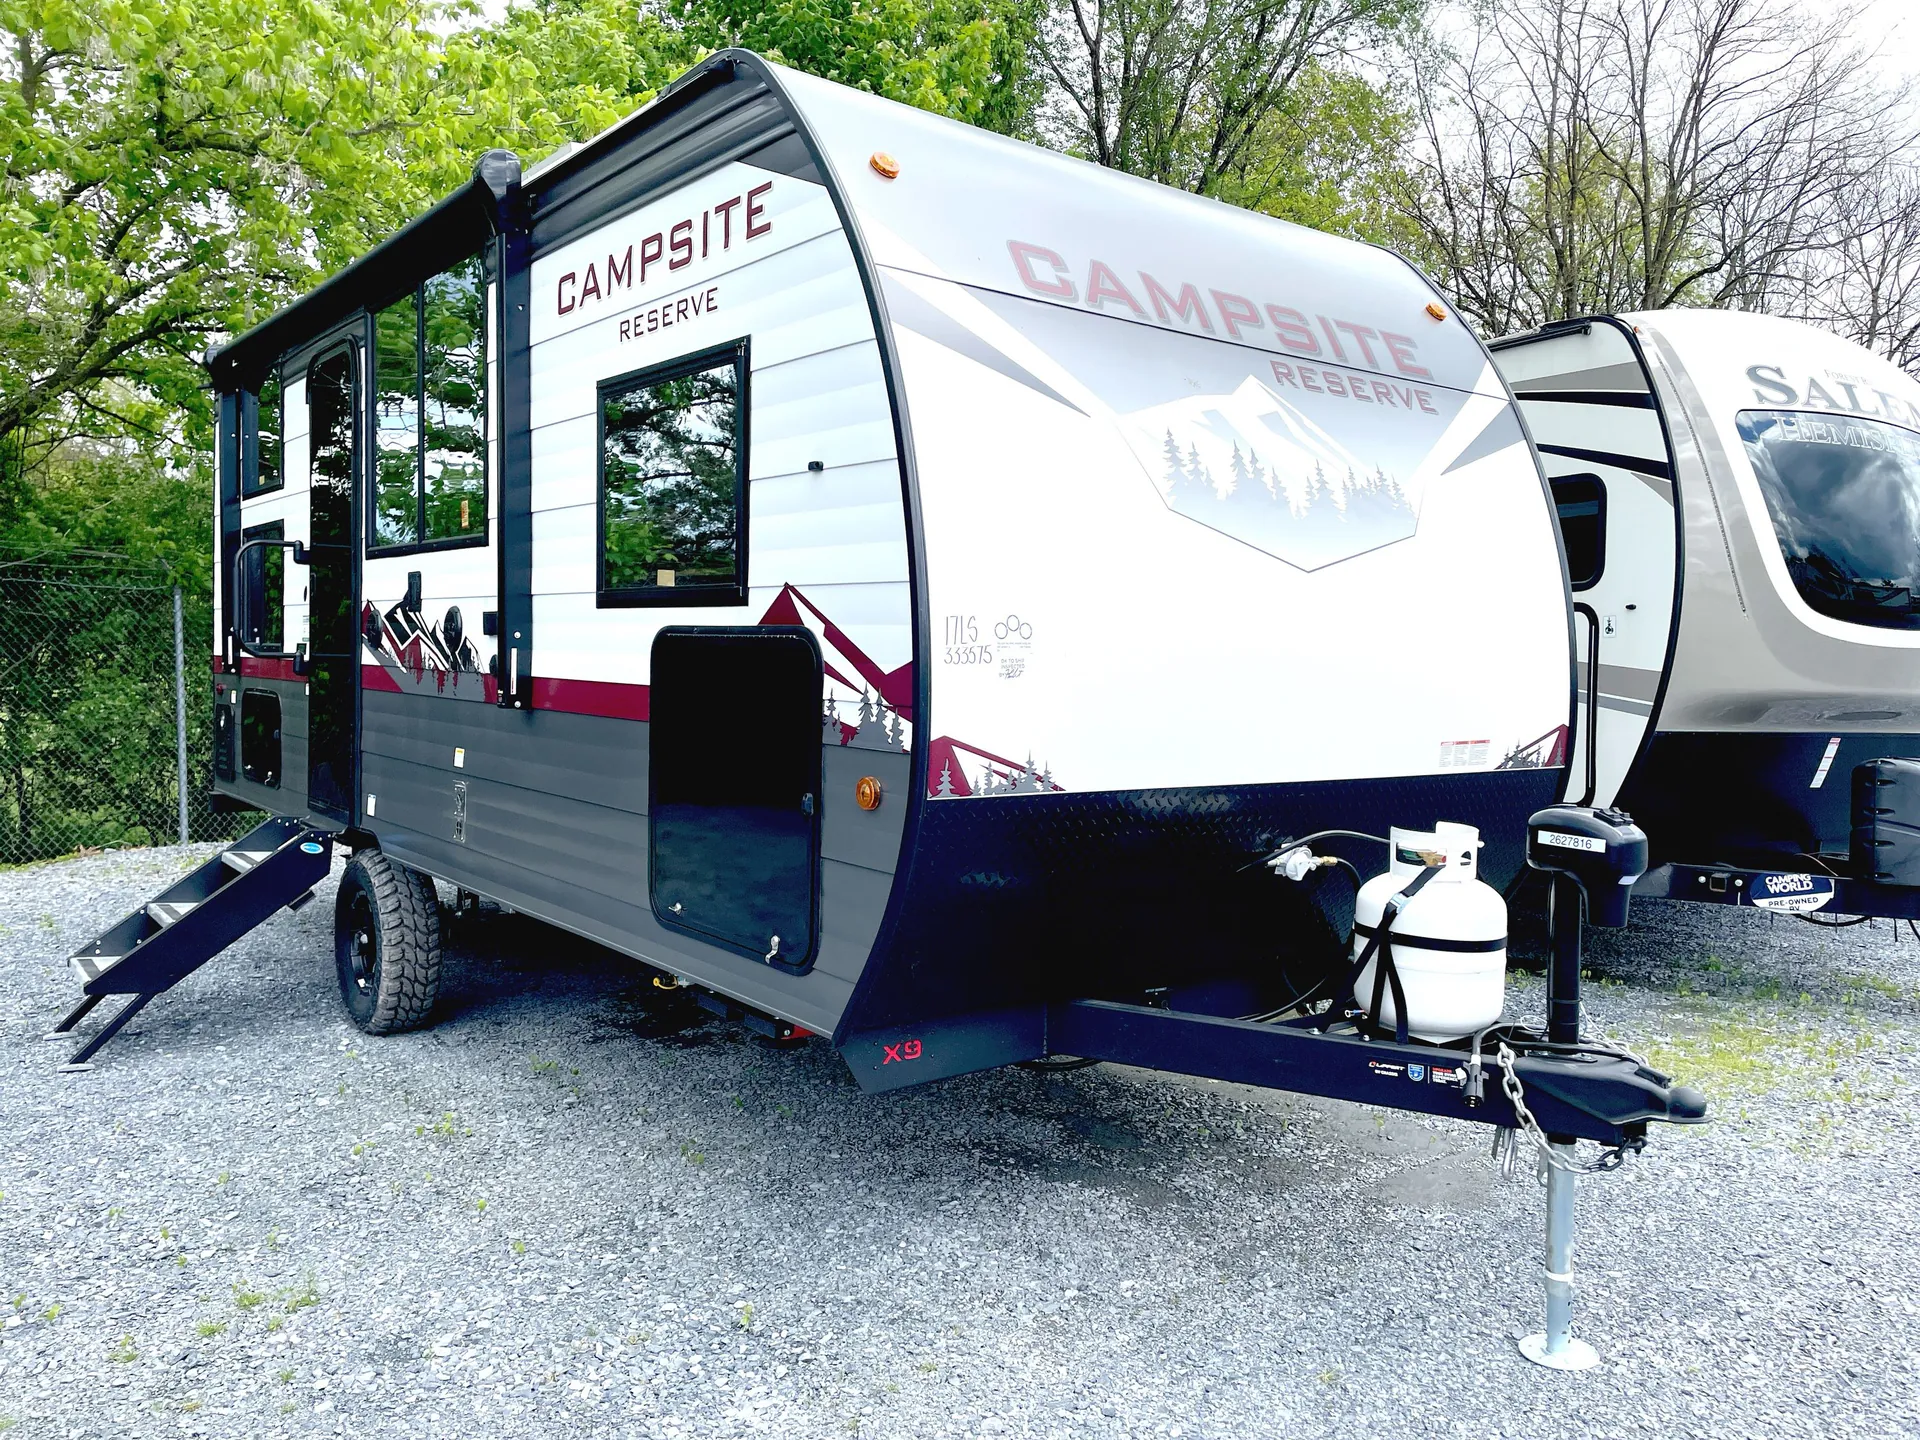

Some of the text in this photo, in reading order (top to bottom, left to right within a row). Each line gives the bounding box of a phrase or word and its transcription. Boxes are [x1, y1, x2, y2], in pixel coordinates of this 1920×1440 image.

[557, 180, 773, 316] CAMPSITE
[619, 286, 719, 343] RESERVE
[1006, 239, 1435, 381] CAMPSITE
[1269, 359, 1439, 416] RESERVE
[943, 644, 993, 665] 333575
[1549, 833, 1592, 850] 2627816
[1765, 873, 1811, 885] CAMPING
[1766, 881, 1813, 894] WORLD
[1768, 896, 1819, 907] PRE-OWNED
[881, 1039, 923, 1065] X9
